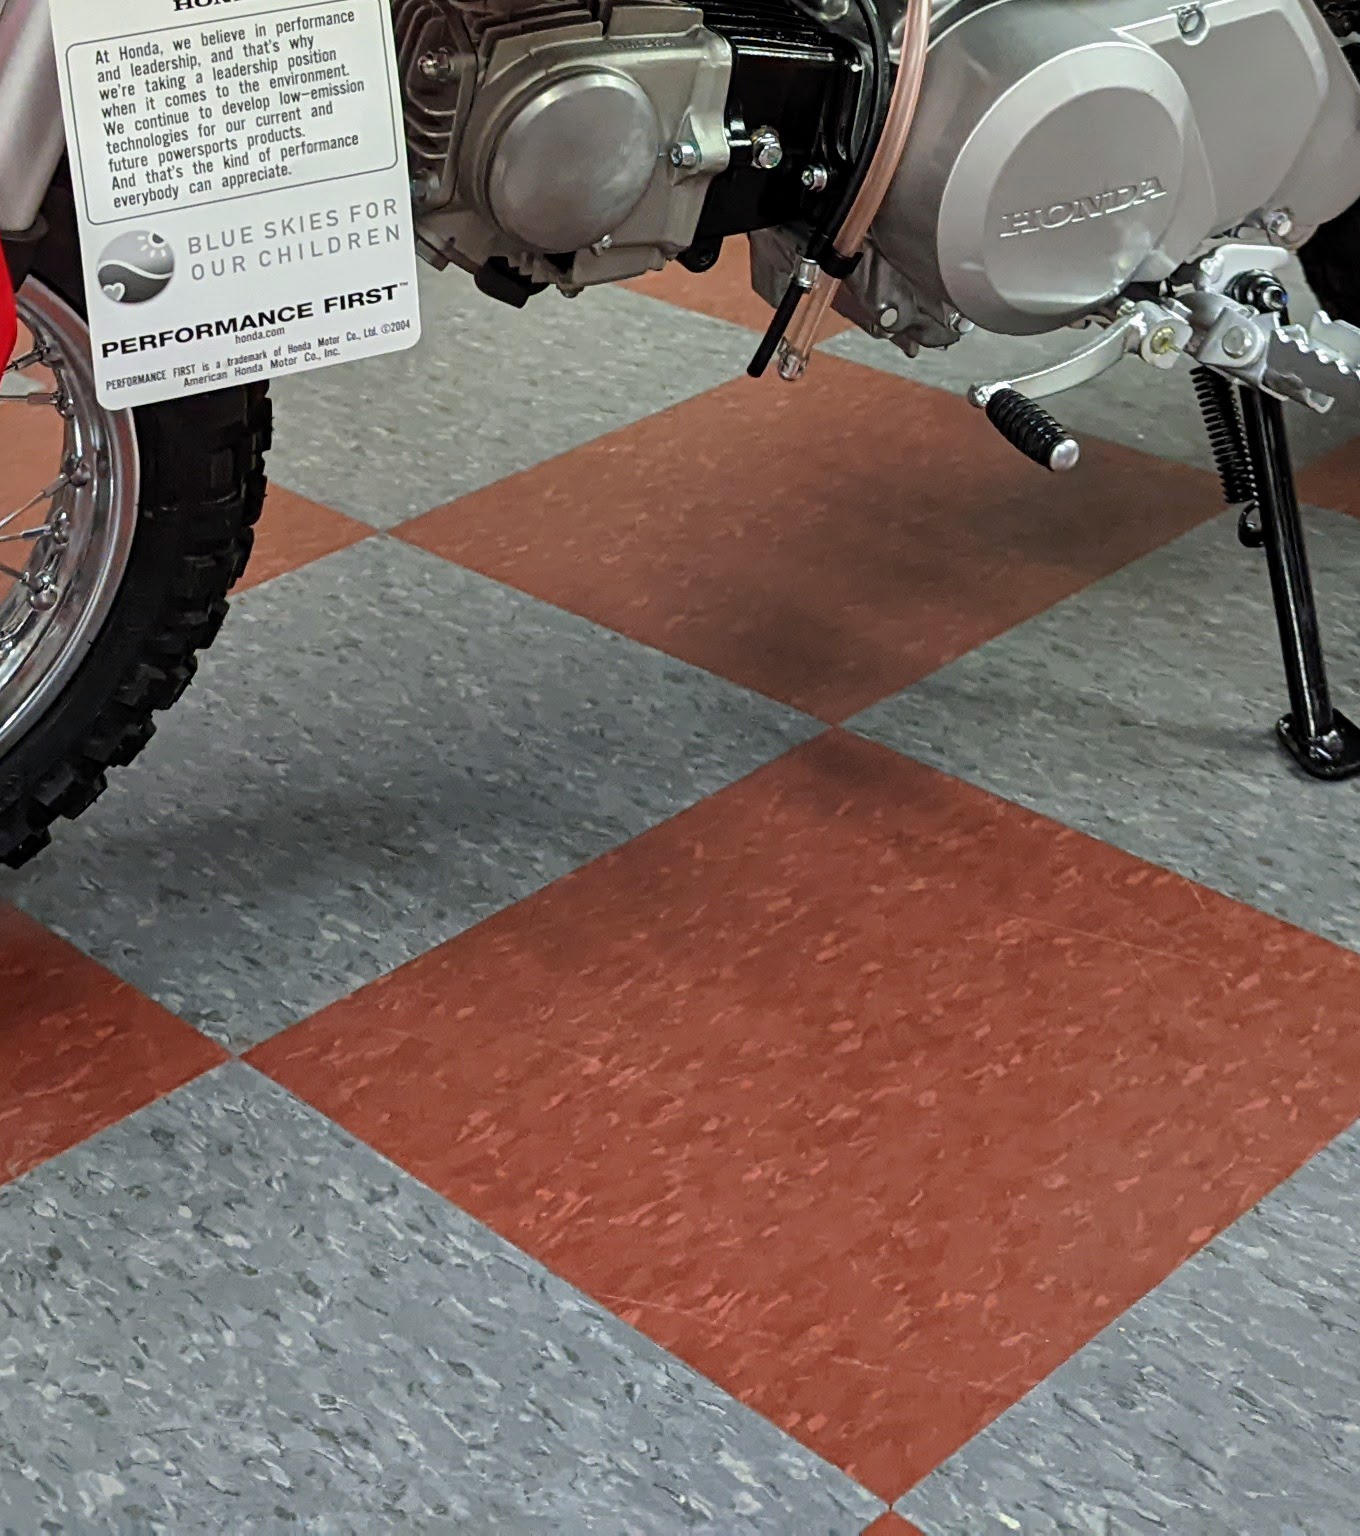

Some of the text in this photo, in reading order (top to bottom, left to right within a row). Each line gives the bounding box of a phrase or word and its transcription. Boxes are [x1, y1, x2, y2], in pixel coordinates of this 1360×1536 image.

[95, 11, 355, 64] At Honda, we believe in performance
[98, 34, 314, 83] and leadership, and that's why
[99, 49, 337, 101] we're taking a leadership position
[102, 64, 350, 118] when it comes to the environment.
[104, 122, 124, 136] We
[135, 111, 189, 131] continue
[199, 107, 212, 119] to
[222, 93, 270, 115] develop
[106, 101, 333, 154] technologies for our current and
[109, 126, 305, 172] future powersports products.
[112, 133, 359, 190] And that's the kind of performance
[114, 166, 291, 208] everybody can appreciate.
[1000, 177, 1167, 238] HONDA
[189, 198, 398, 254] BLUE SKIES FOR
[191, 224, 400, 280] OUR CHILDREN
[102, 302, 314, 358] PERFORMANCE
[235, 327, 285, 344] honda.com
[106, 370, 166, 391] PERFORMANCE
[174, 365, 195, 378] FIRST
[202, 362, 210, 371] is
[216, 361, 221, 369] a
[227, 350, 267, 366] trademark
[274, 347, 281, 357] of
[288, 342, 311, 355] Honda
[318, 336, 340, 348] Motor
[364, 328, 378, 339] Ltd.
[184, 348, 340, 387] American Honda Motor Co., Inc.
